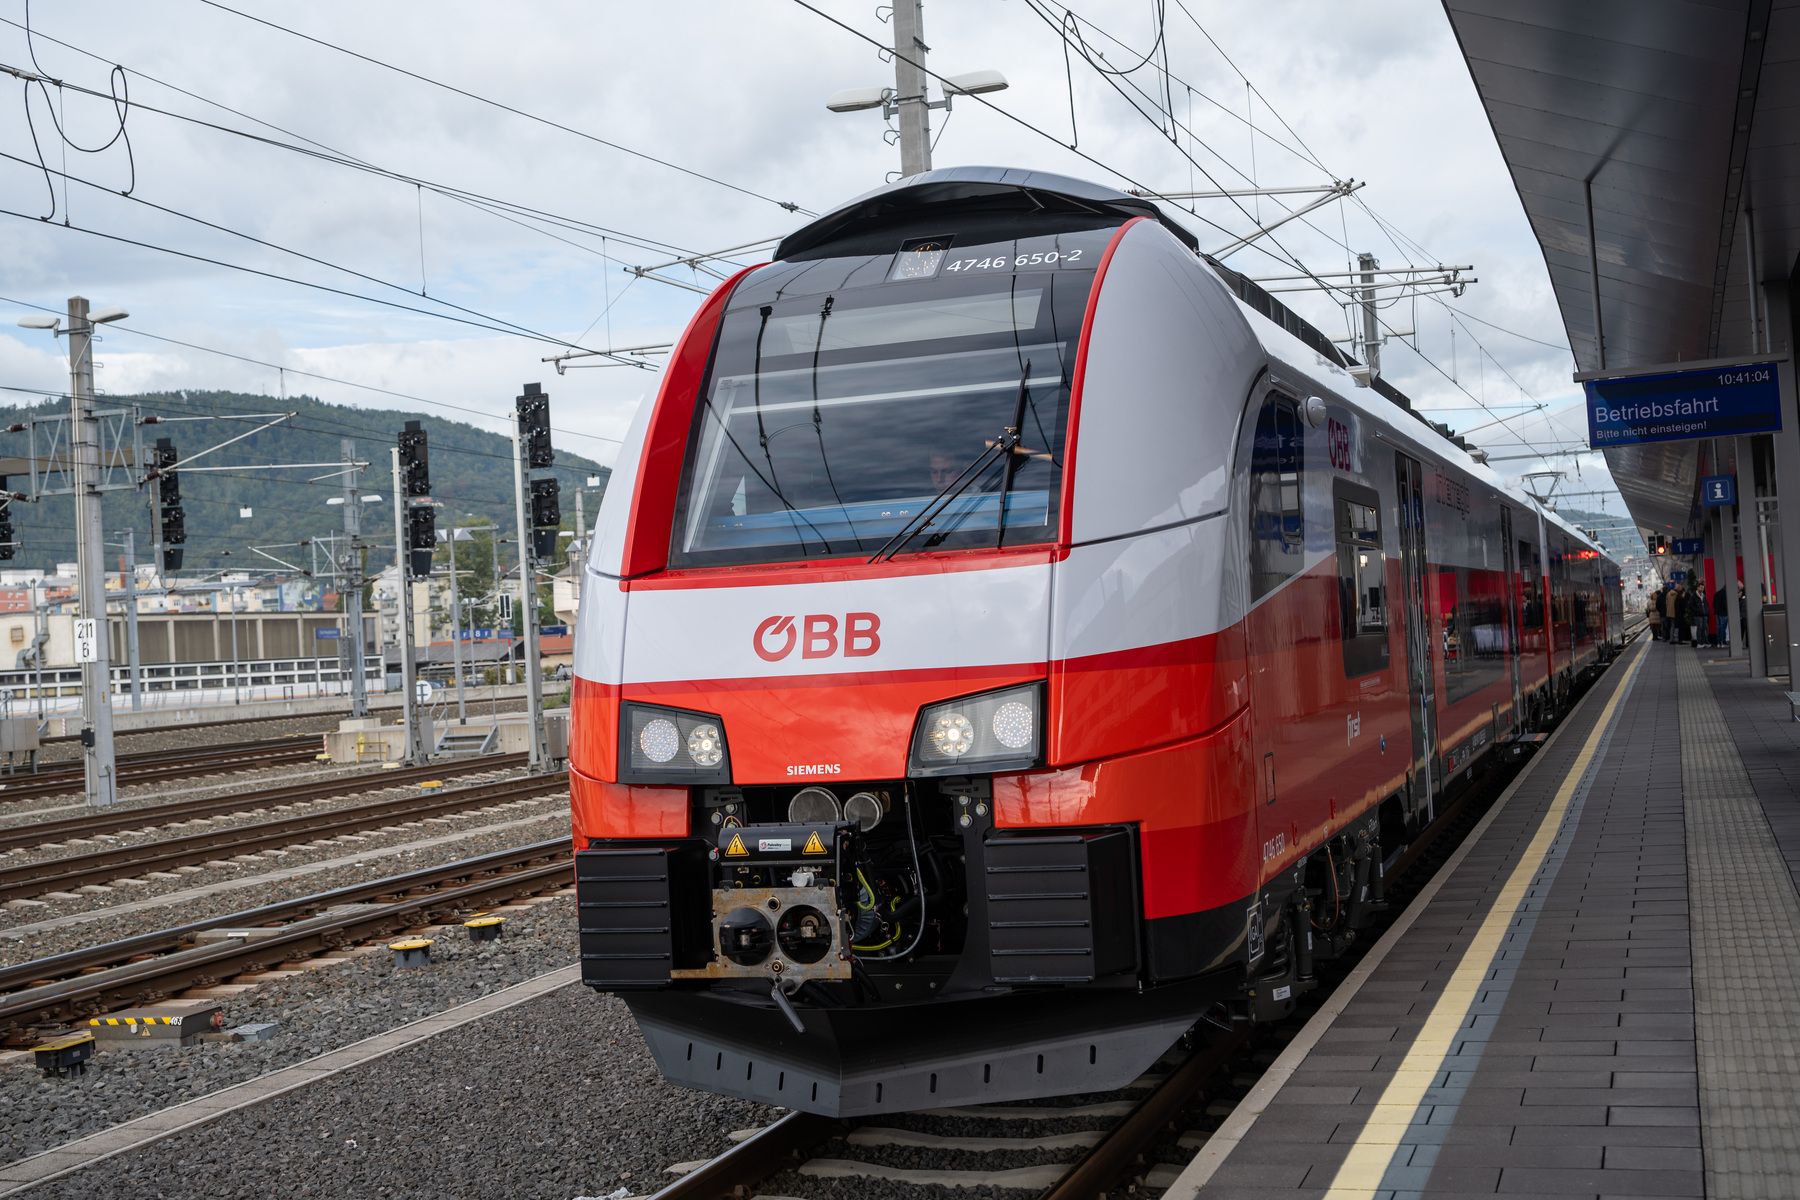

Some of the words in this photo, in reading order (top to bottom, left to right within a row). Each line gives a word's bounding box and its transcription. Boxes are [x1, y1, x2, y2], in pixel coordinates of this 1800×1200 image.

[946, 256, 1007, 272] 4746
[1014, 249, 1083, 266] 650-2
[1717, 370, 1770, 386] 10:41:04
[1595, 396, 1719, 423] Betriebsfahrt
[1596, 430, 1620, 440] Bitte
[1622, 426, 1648, 437] nicht
[1650, 421, 1707, 434] einsteigen!
[1677, 541, 1683, 552] 1
[1693, 543, 1699, 552] F
[77, 622, 93, 639] 211
[753, 611, 881, 662] ÖBB
[82, 641, 90, 658] 6
[786, 763, 841, 776] SIEMENS
[1275, 832, 1286, 857] 650
